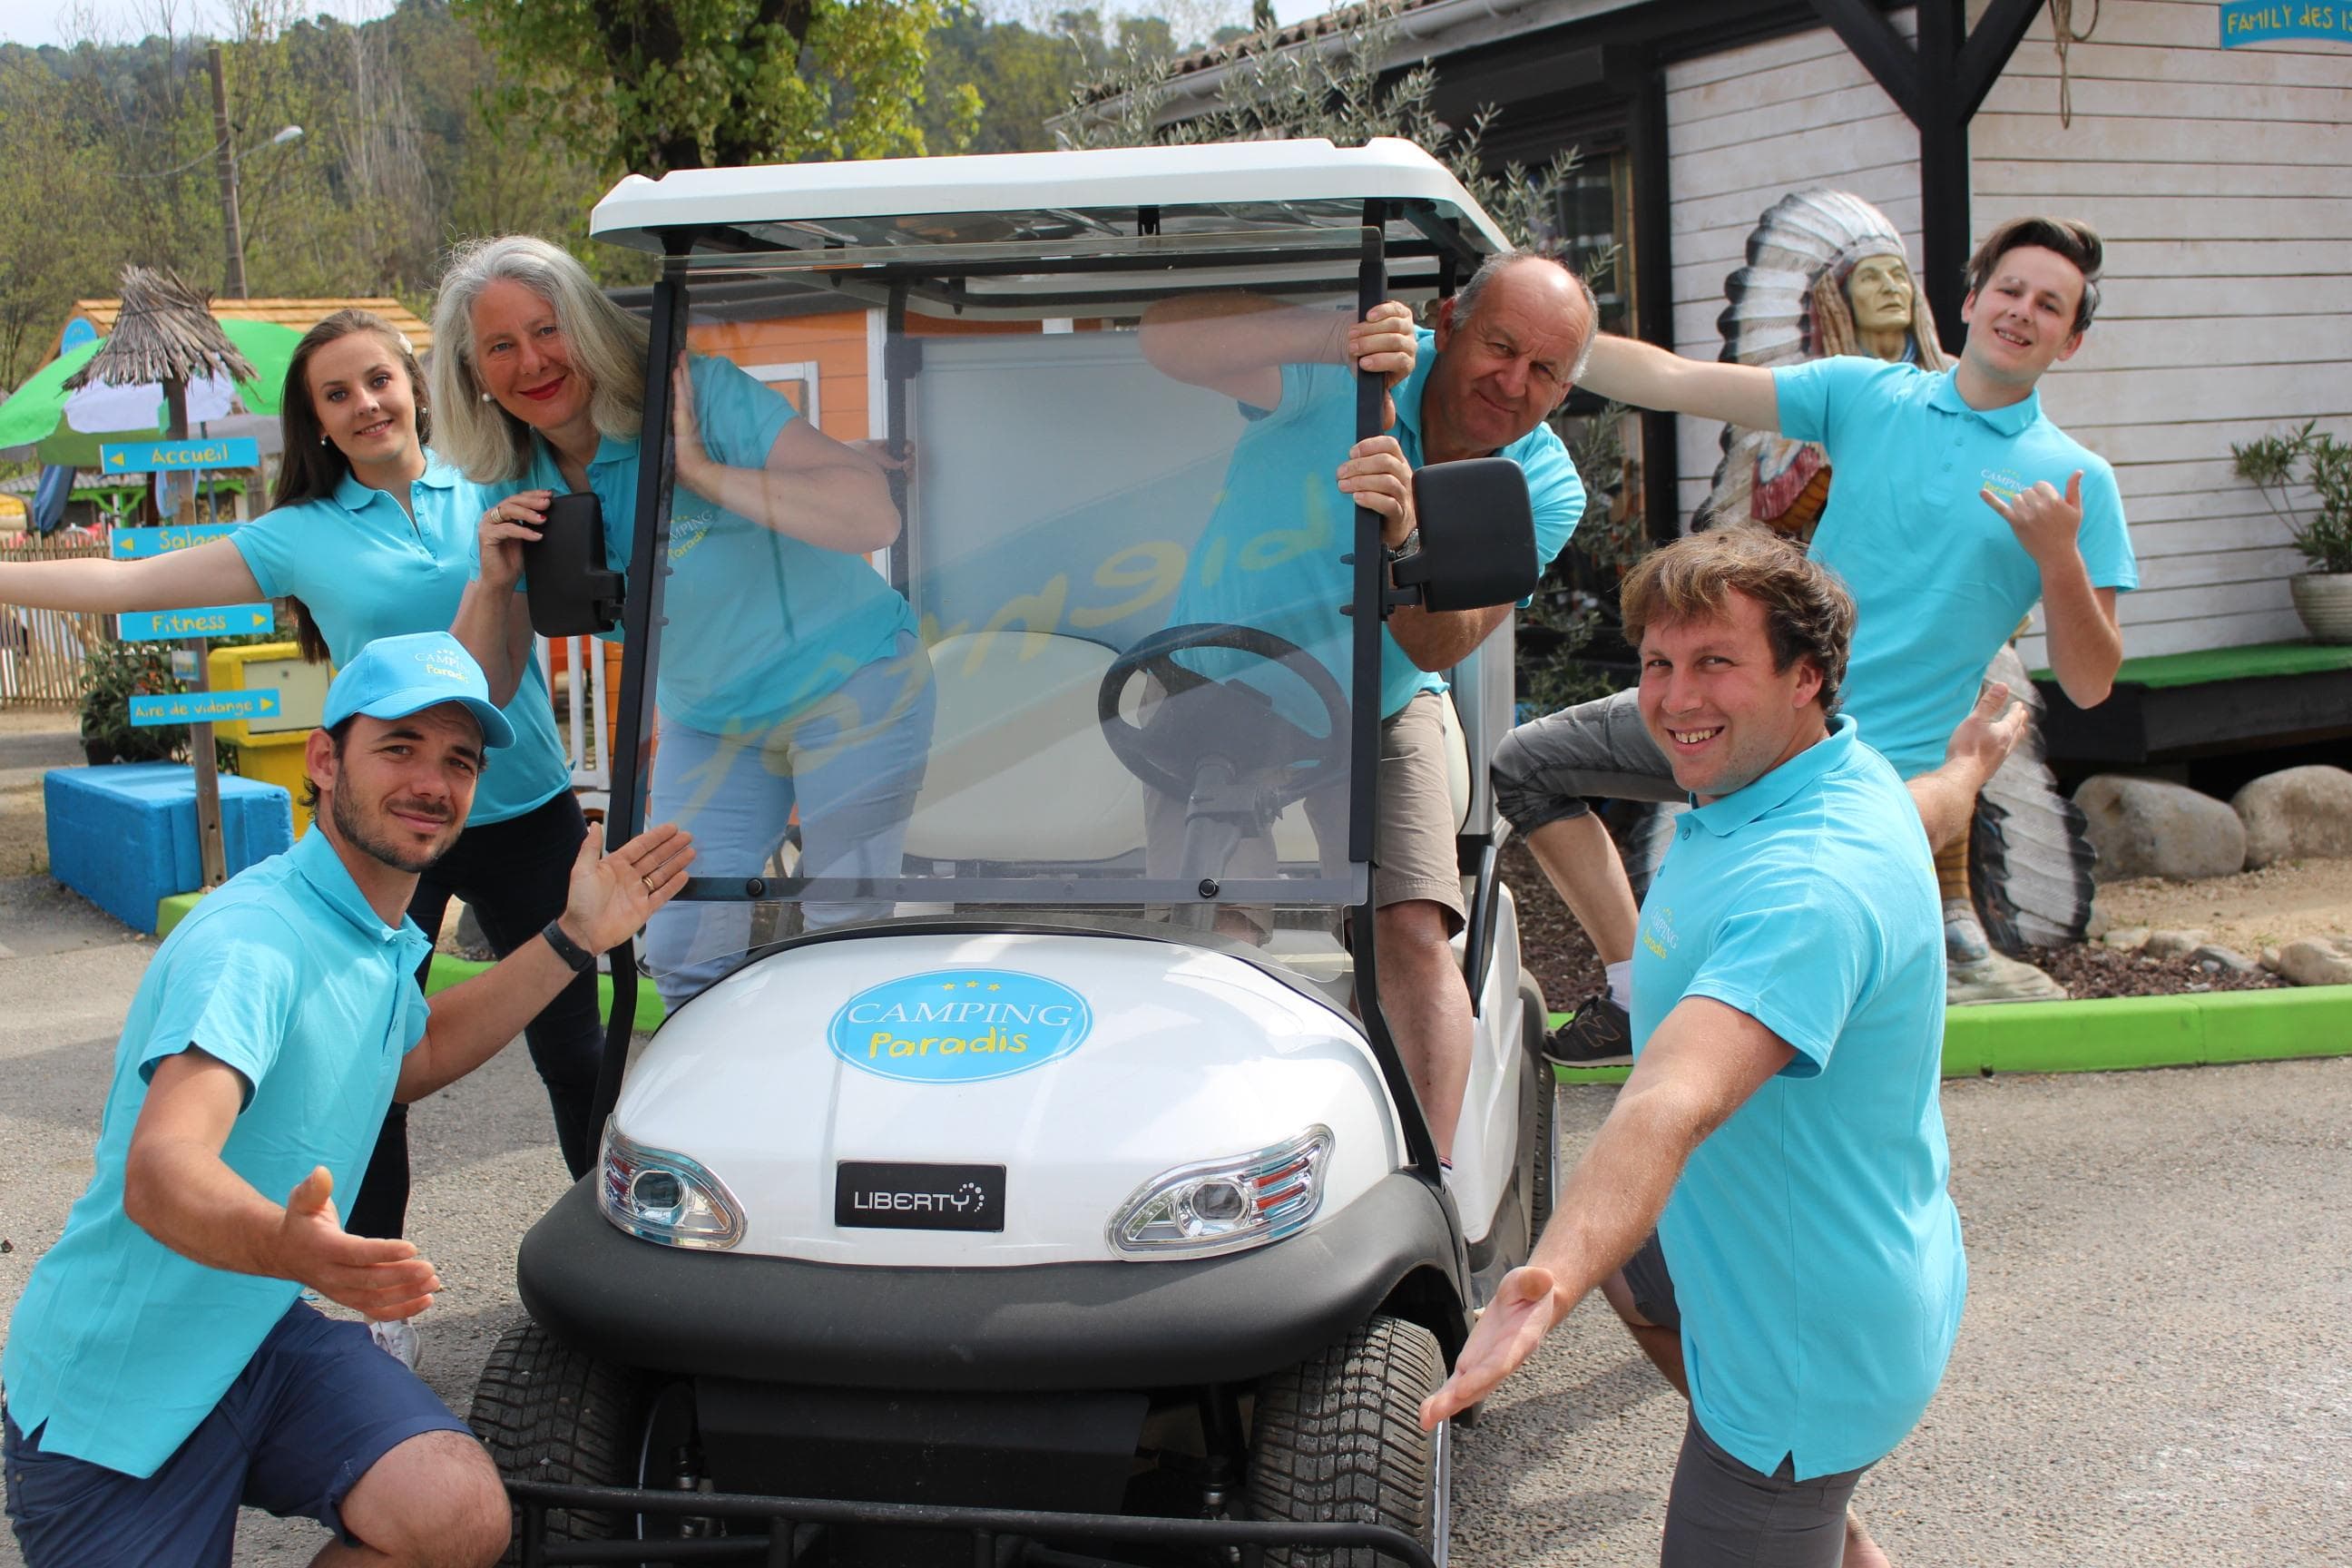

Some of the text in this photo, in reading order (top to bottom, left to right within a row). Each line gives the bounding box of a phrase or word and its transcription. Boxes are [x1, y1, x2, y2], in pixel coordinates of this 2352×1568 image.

[2227, 4, 2292, 34] FAMILY
[151, 443, 229, 465] Accueil
[669, 509, 713, 544] MPING
[152, 613, 227, 633] Fitness
[136, 698, 253, 718] Aire de vidange
[847, 1001, 1074, 1027] CAMPING
[868, 1025, 1031, 1060] Paradis
[853, 1190, 971, 1212] LIBERTY
